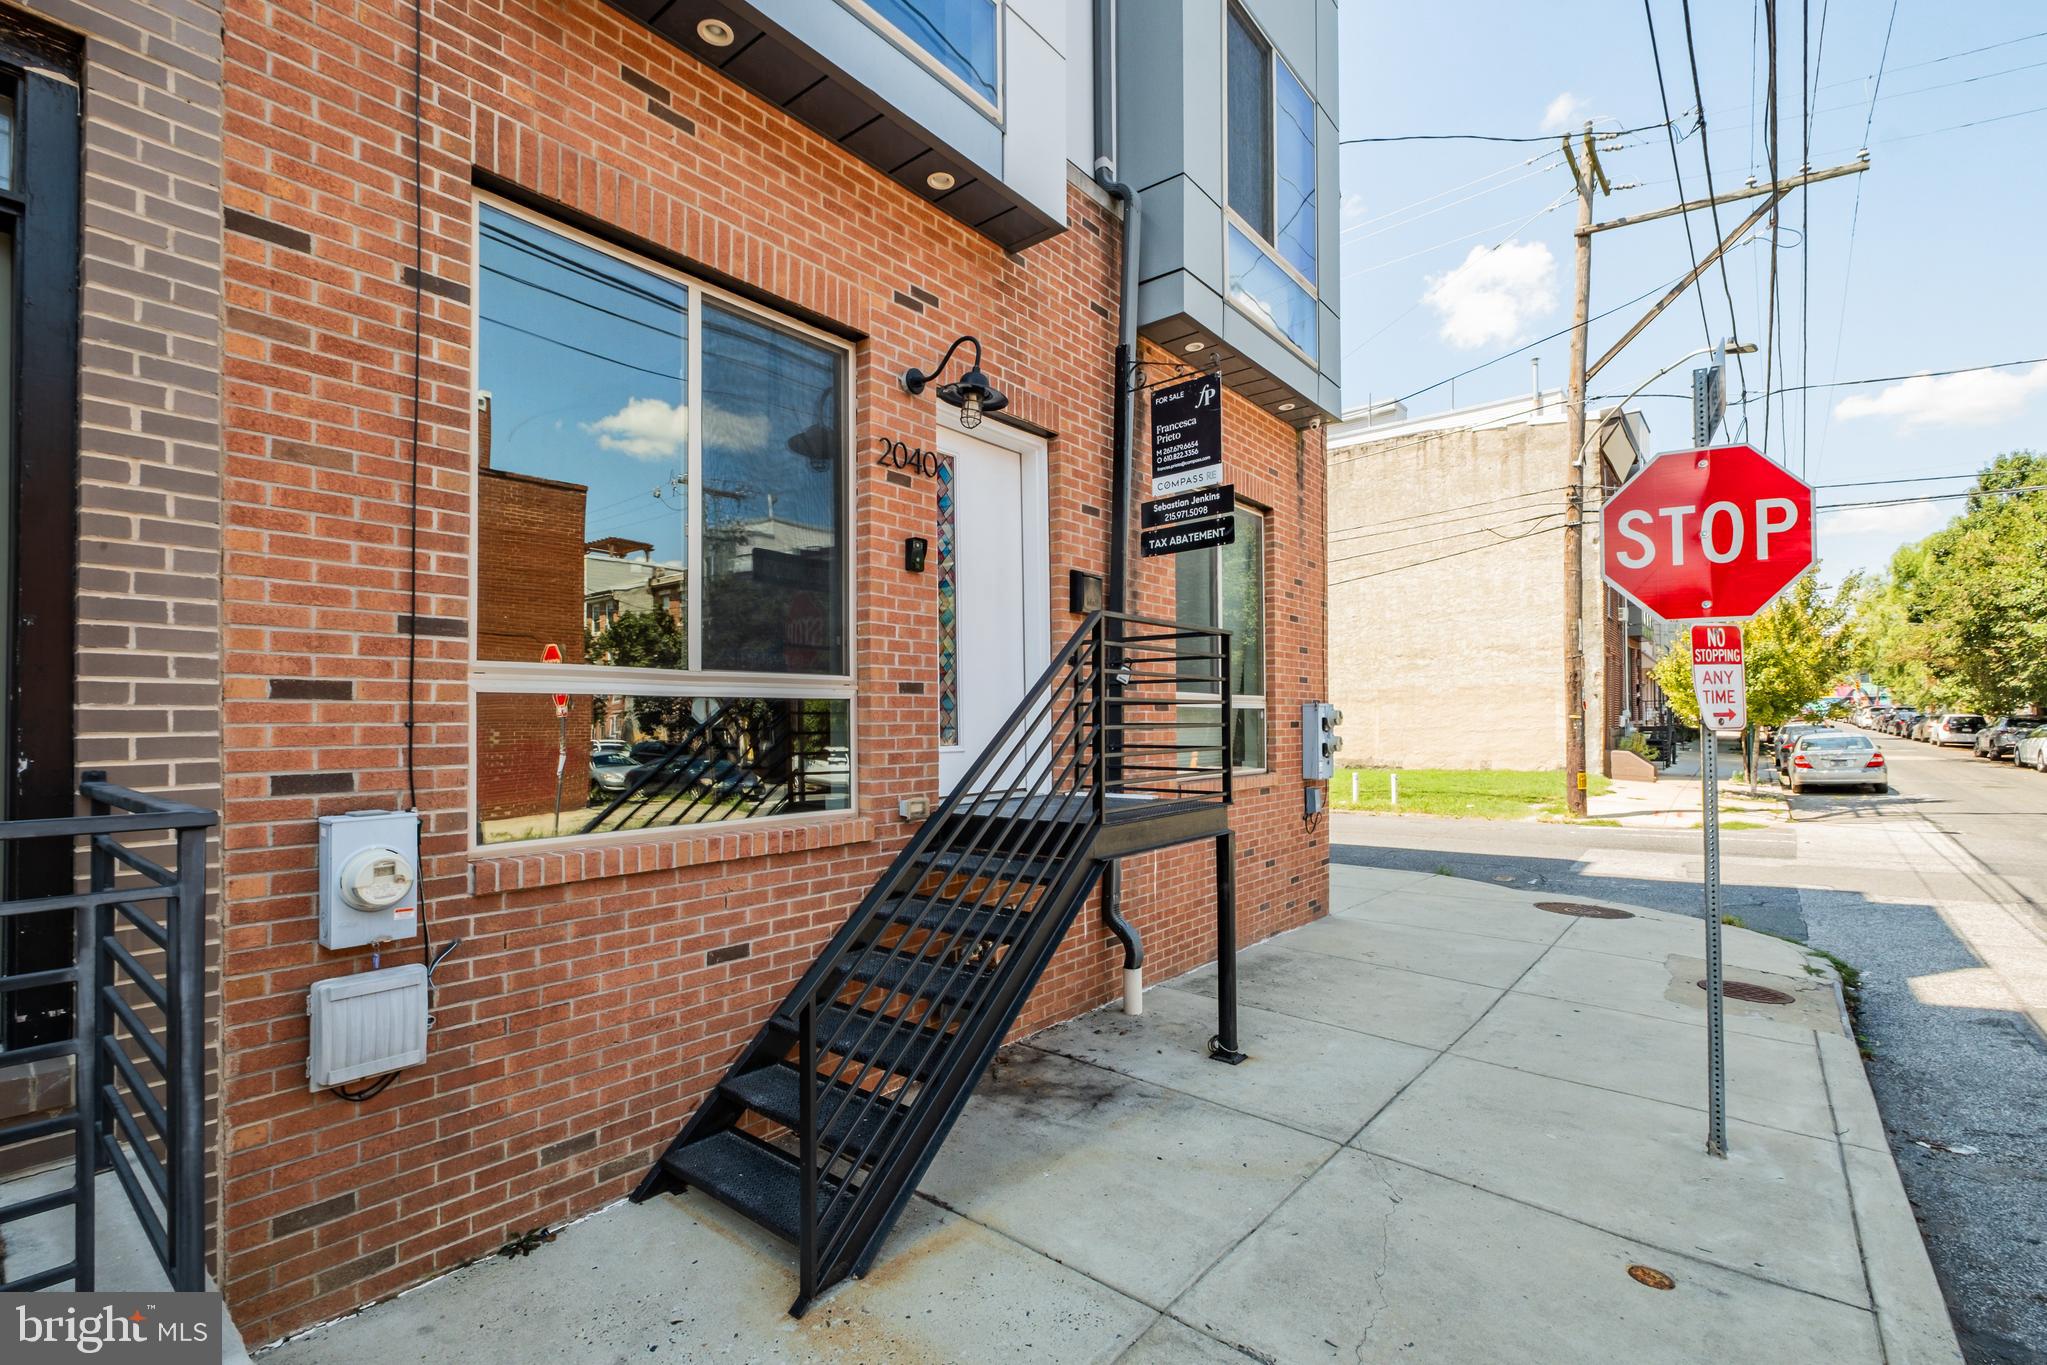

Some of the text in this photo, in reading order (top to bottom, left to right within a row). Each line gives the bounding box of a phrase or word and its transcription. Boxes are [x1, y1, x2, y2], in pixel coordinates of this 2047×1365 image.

[1155, 391, 1185, 405] FOR SALE
[1156, 418, 1197, 434] Francesca
[1156, 432, 1181, 445] Prieto
[1163, 440, 1199, 455] 267.679.6654
[877, 437, 938, 478] 2040
[1157, 470, 1217, 491] COMPASS RE
[1153, 493, 1220, 513] Sebastian Jenkins
[1164, 506, 1208, 522] 215.971.5098
[1149, 527, 1225, 549] TAX ABATEMENT
[1616, 498, 1798, 569] STOP
[1707, 627, 1726, 647] NO
[1694, 648, 1741, 662] STOPPING
[1703, 670, 1734, 685] ANY
[1703, 690, 1735, 704] TIME
